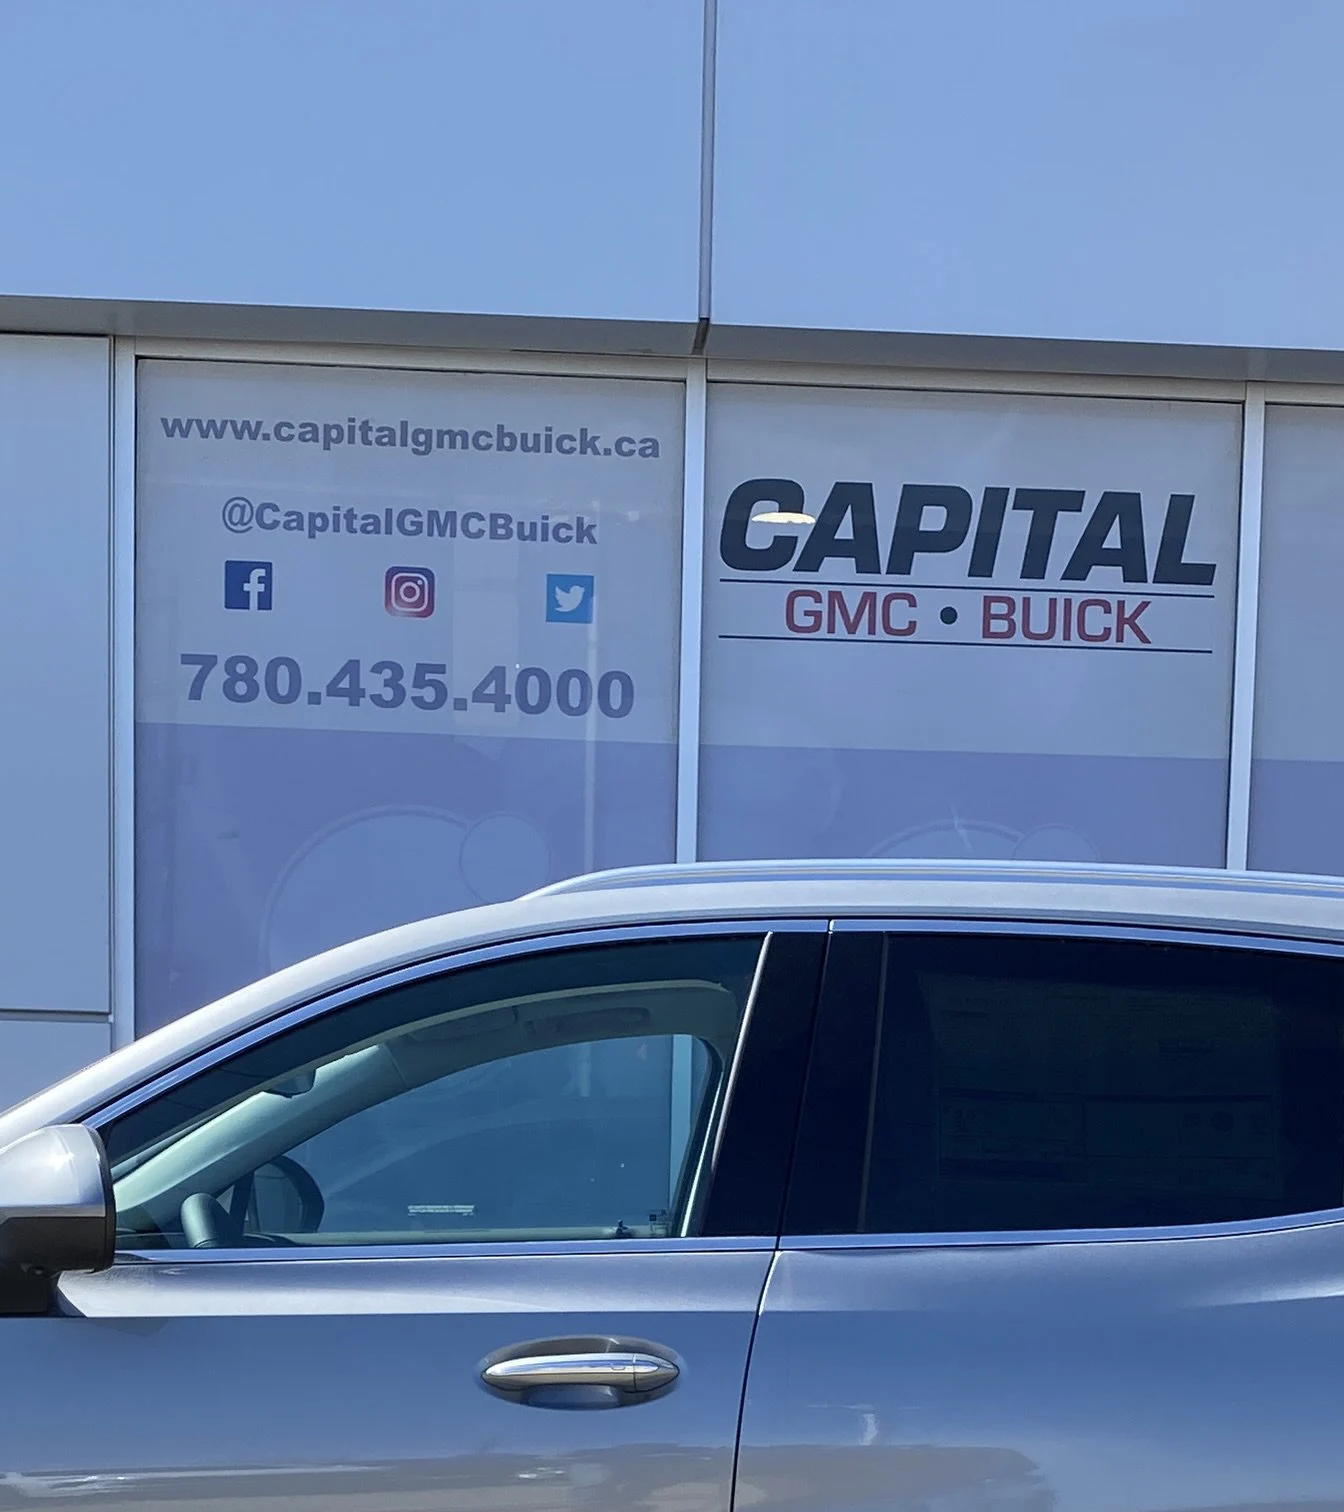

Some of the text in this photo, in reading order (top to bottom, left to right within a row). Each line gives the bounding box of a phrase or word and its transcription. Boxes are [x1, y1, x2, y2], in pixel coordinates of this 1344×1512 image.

[160, 416, 661, 458] www.capitalgmcbuick.ca
[222, 496, 598, 545] @CapitalGMCBuick
[719, 478, 1217, 586] CAPITAL
[785, 589, 1152, 645] GMC BUICK
[180, 653, 636, 719] 780.435.4000
